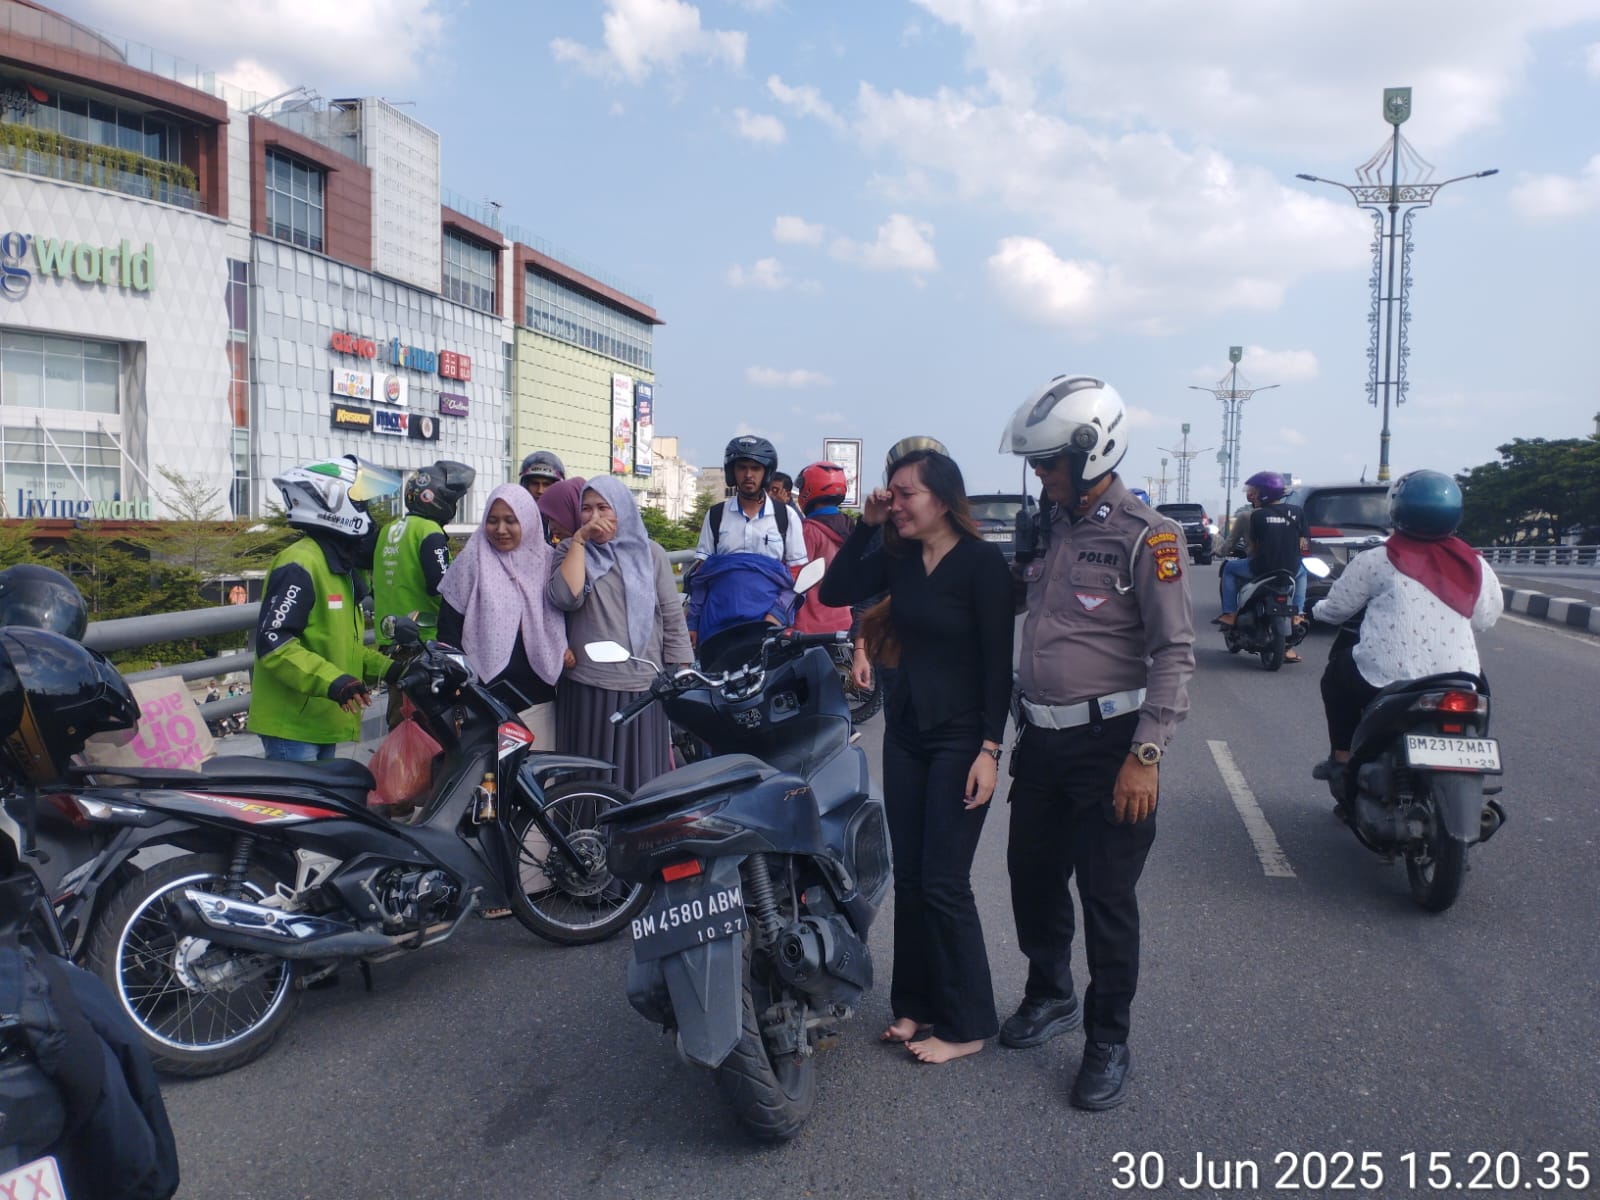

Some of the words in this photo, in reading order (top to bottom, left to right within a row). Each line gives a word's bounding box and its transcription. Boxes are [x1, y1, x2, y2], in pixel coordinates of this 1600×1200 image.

[1077, 551, 1119, 567] POLRI
[631, 915, 656, 940] BM
[659, 900, 702, 932] 4580
[708, 887, 742, 915] ABM
[697, 929, 716, 943] 10
[725, 918, 743, 934] 27
